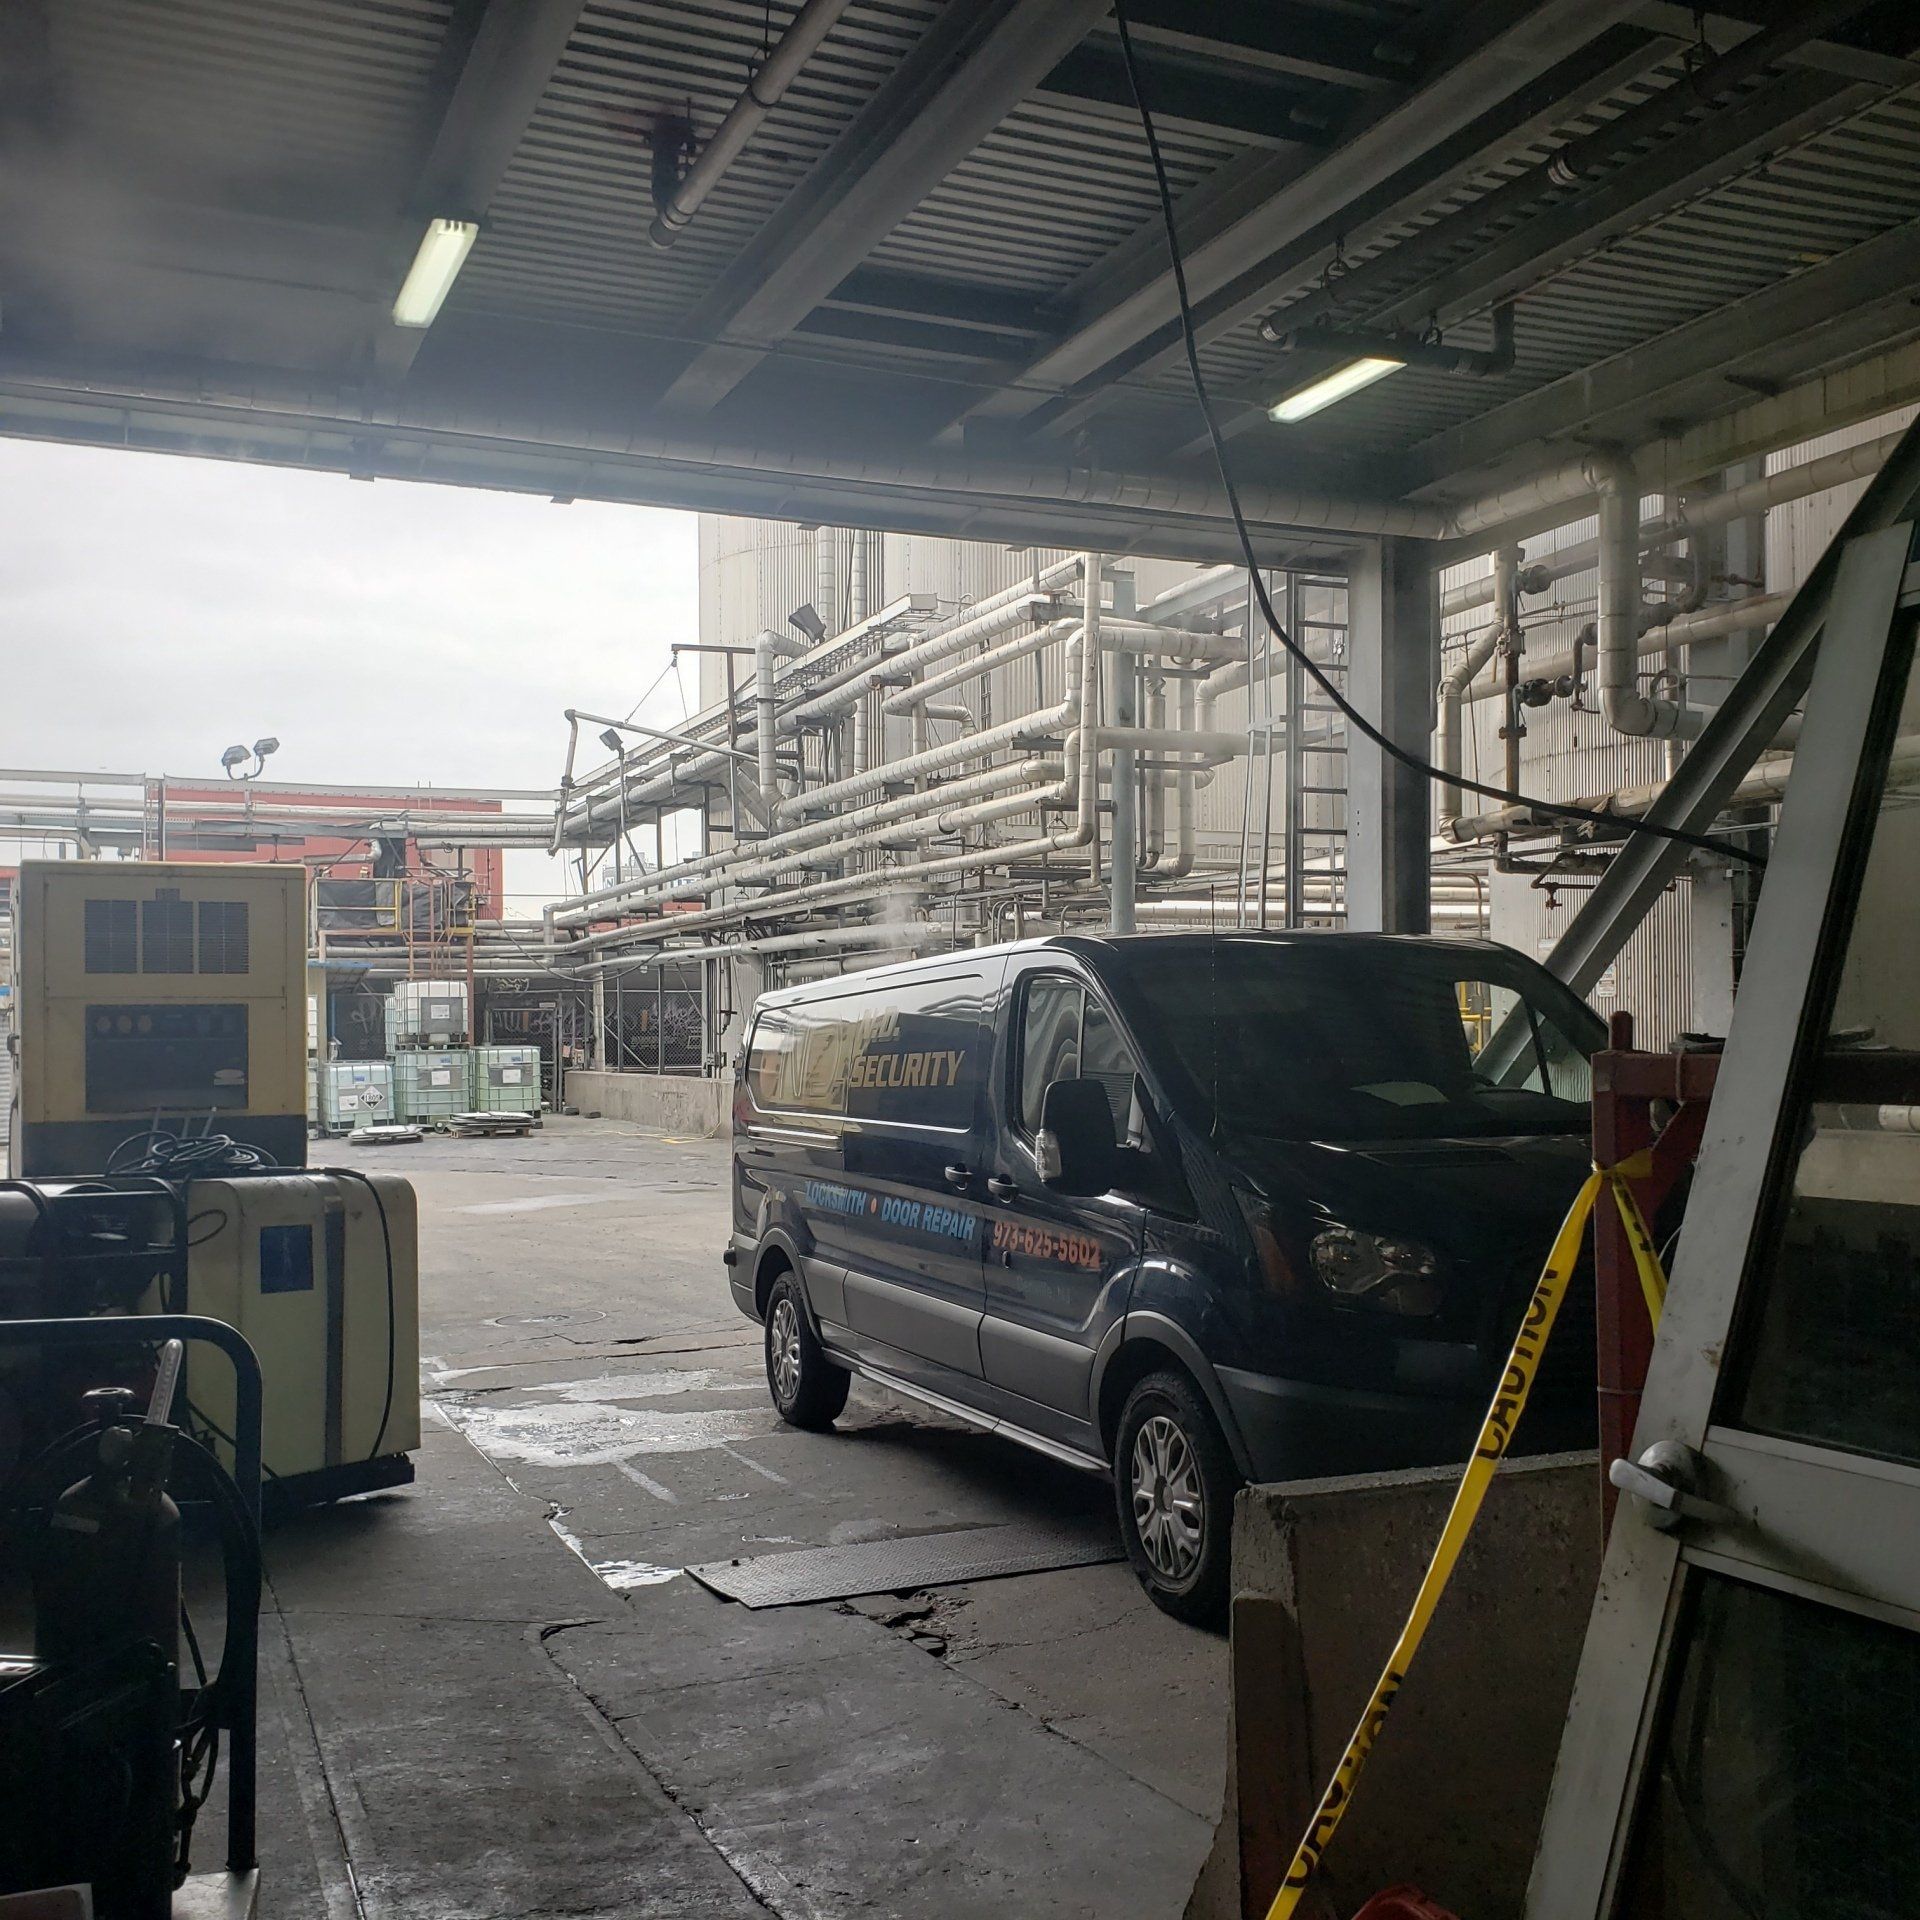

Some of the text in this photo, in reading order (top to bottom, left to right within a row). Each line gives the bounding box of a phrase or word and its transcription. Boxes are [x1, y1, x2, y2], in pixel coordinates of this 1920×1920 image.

[850, 1050, 965, 1087] SECURITY
[805, 1180, 977, 1240] LOCKSMITH DOOR REPAIR
[992, 1220, 1102, 1268] 973-625-5602
